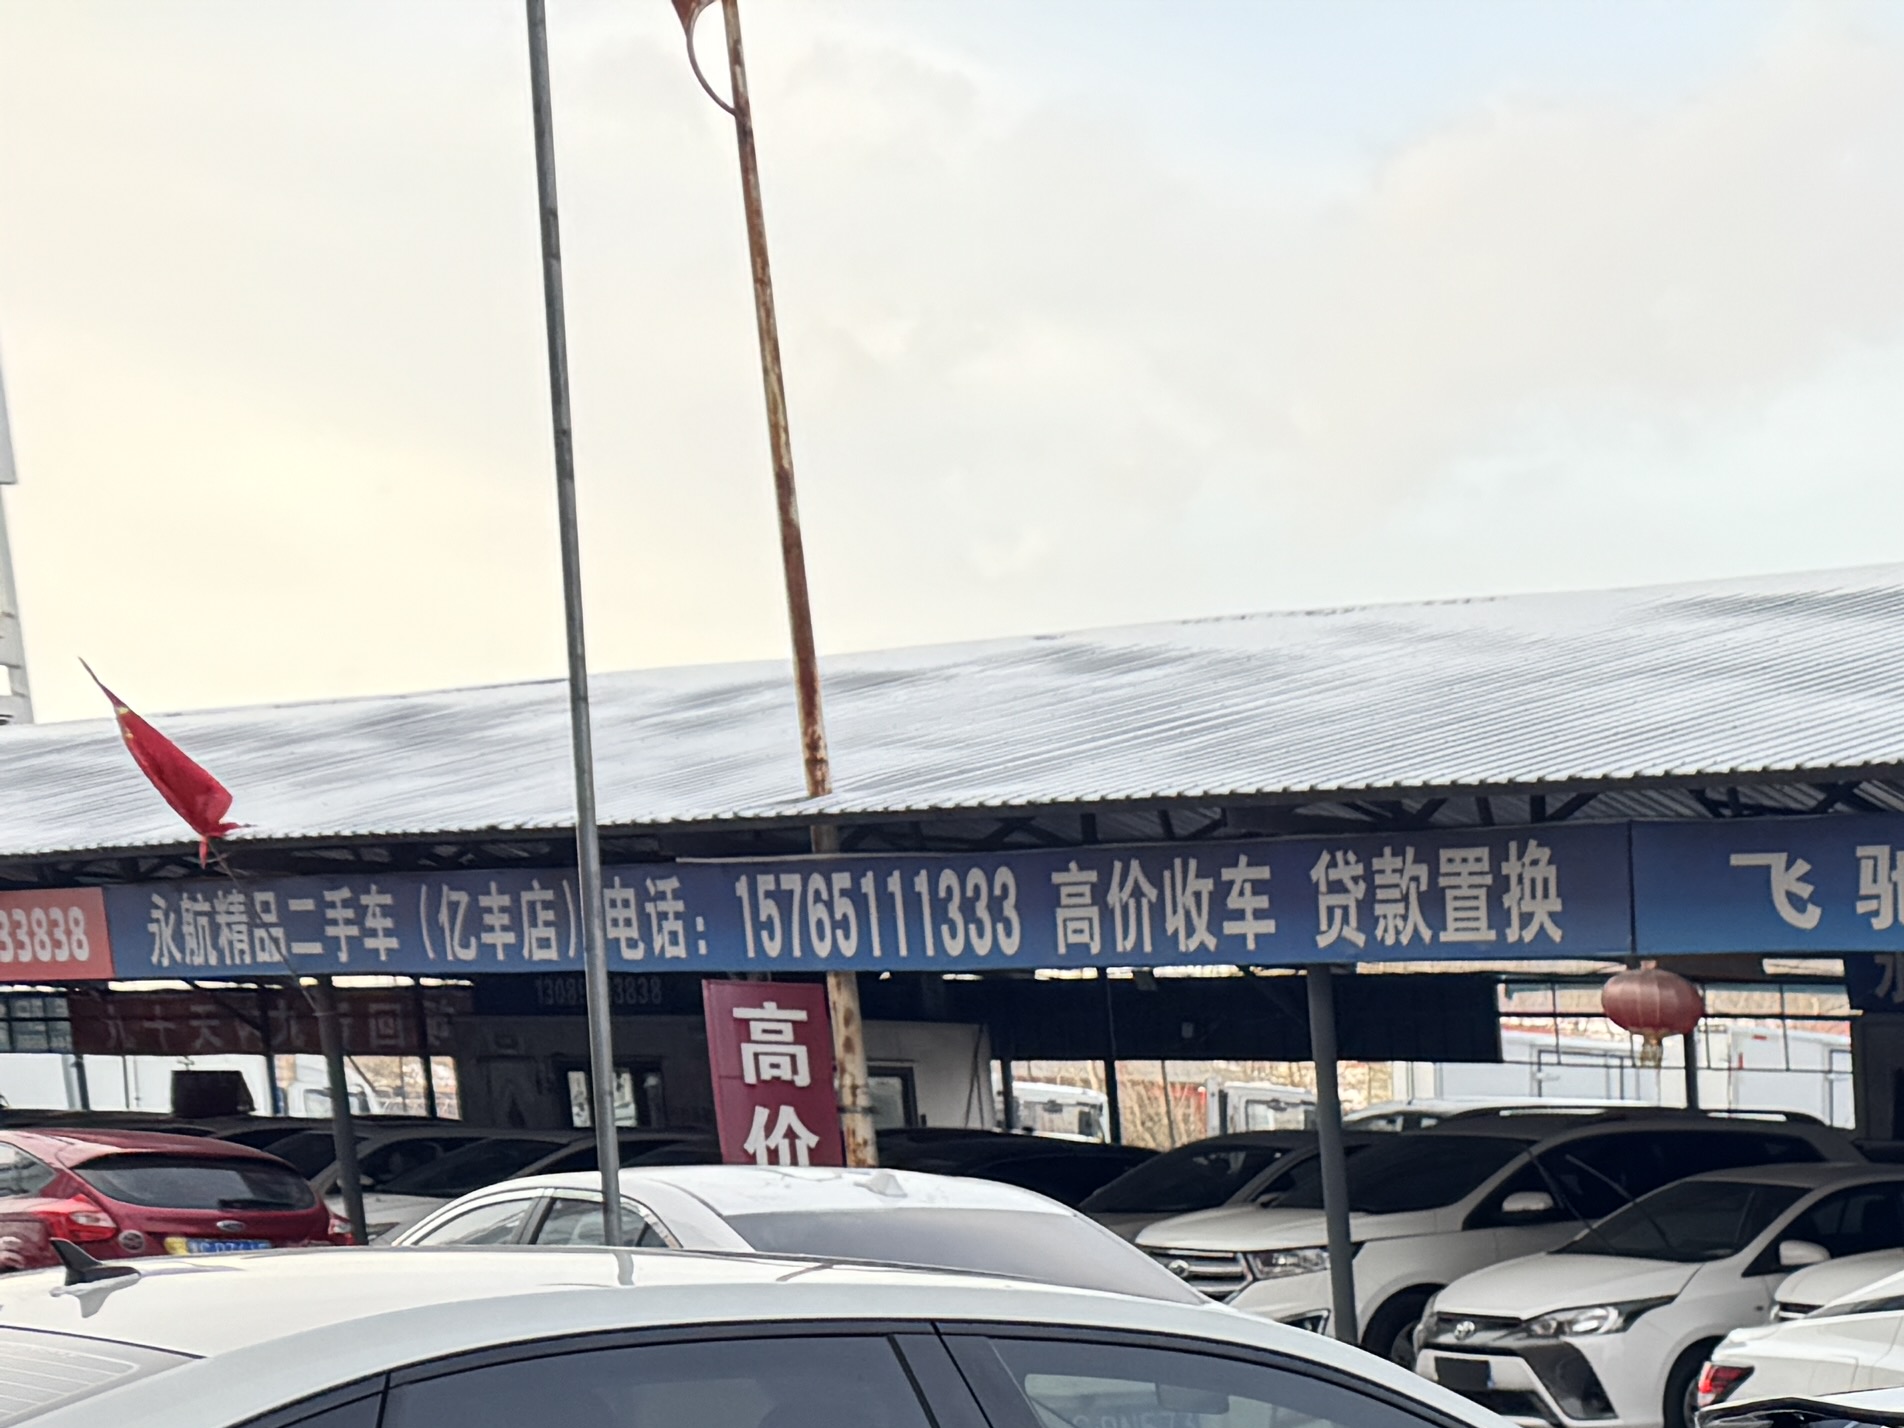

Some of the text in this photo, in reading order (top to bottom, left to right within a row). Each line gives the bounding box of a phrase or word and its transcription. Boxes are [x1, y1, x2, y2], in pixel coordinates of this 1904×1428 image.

[735, 866, 1021, 958] 15765111333
[1051, 854, 1277, 955] 高价收车
[1309, 839, 1564, 950] 贷款置换
[732, 1001, 820, 1166] 高价
